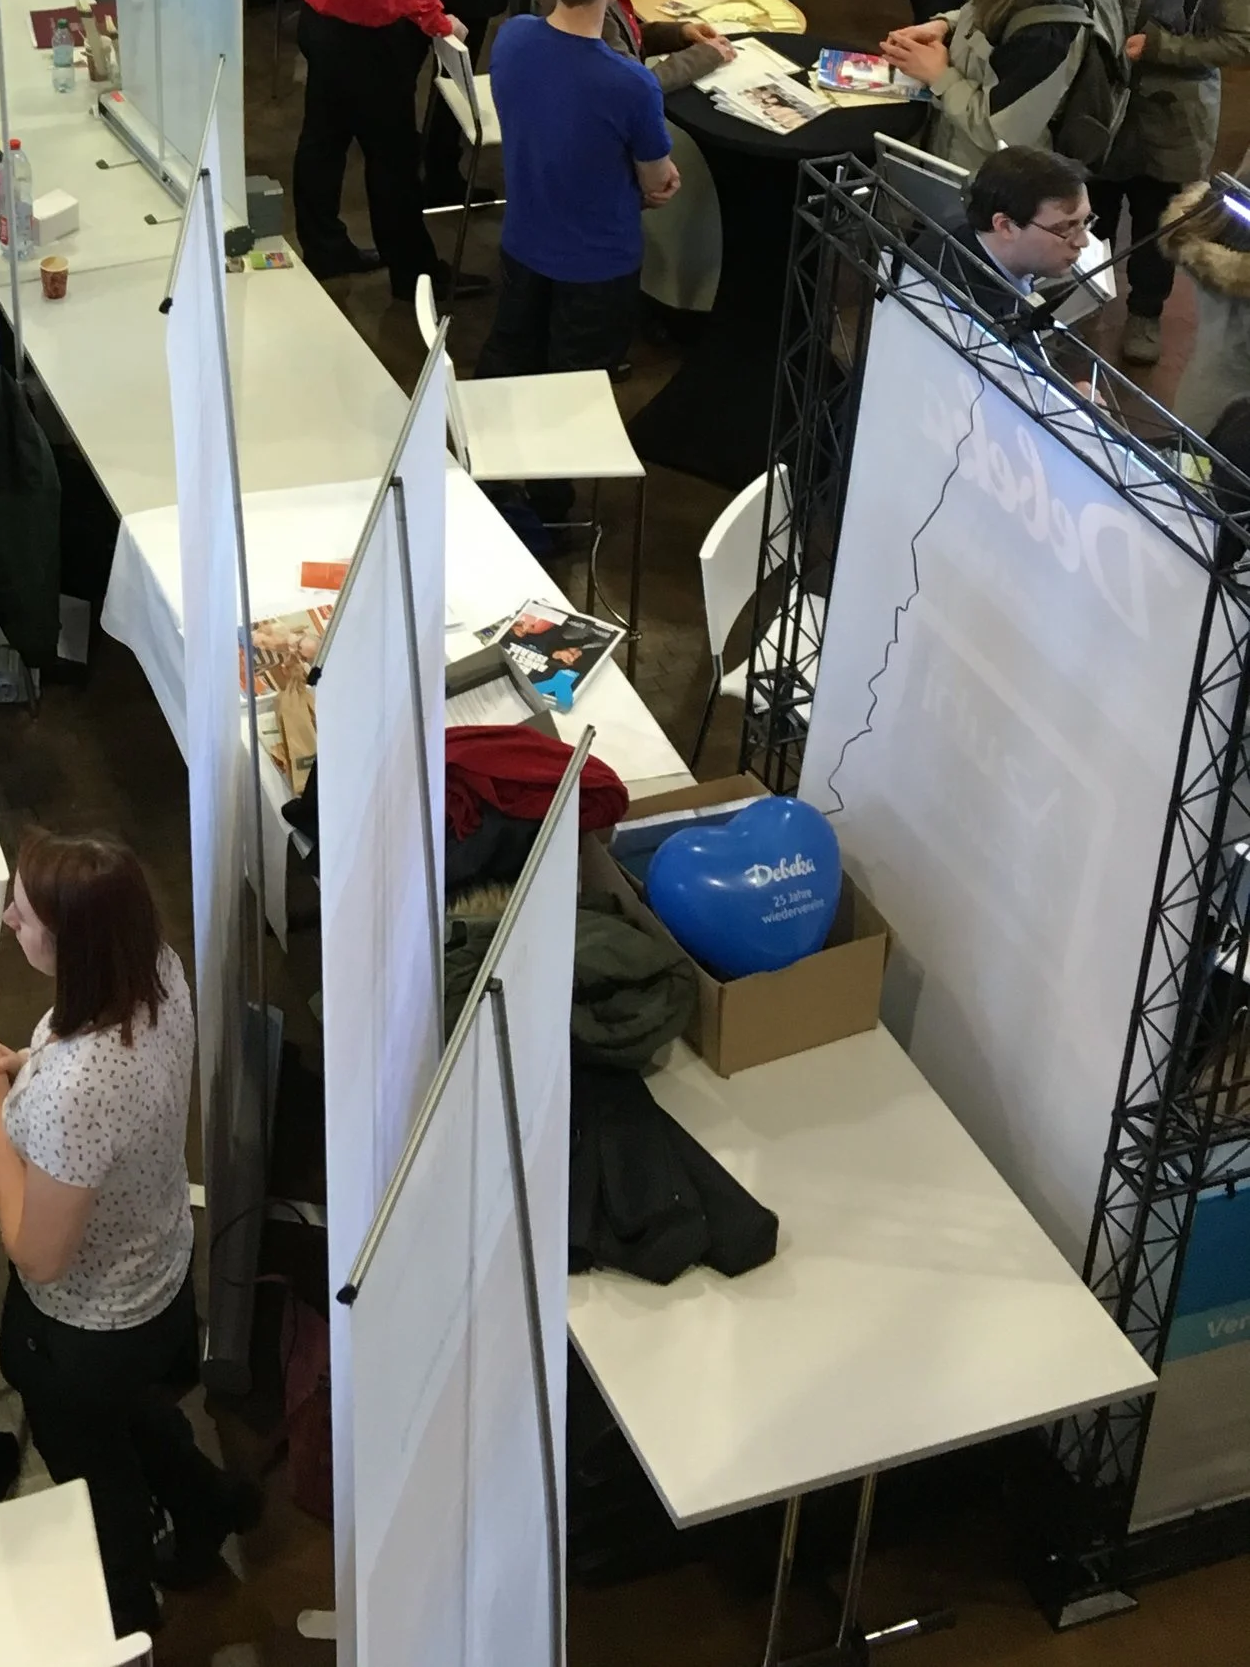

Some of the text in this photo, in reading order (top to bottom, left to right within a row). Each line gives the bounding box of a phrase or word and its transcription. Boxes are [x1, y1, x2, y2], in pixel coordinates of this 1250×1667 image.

[744, 852, 817, 889] Debeka
[772, 889, 813, 908] 25 Jahre
